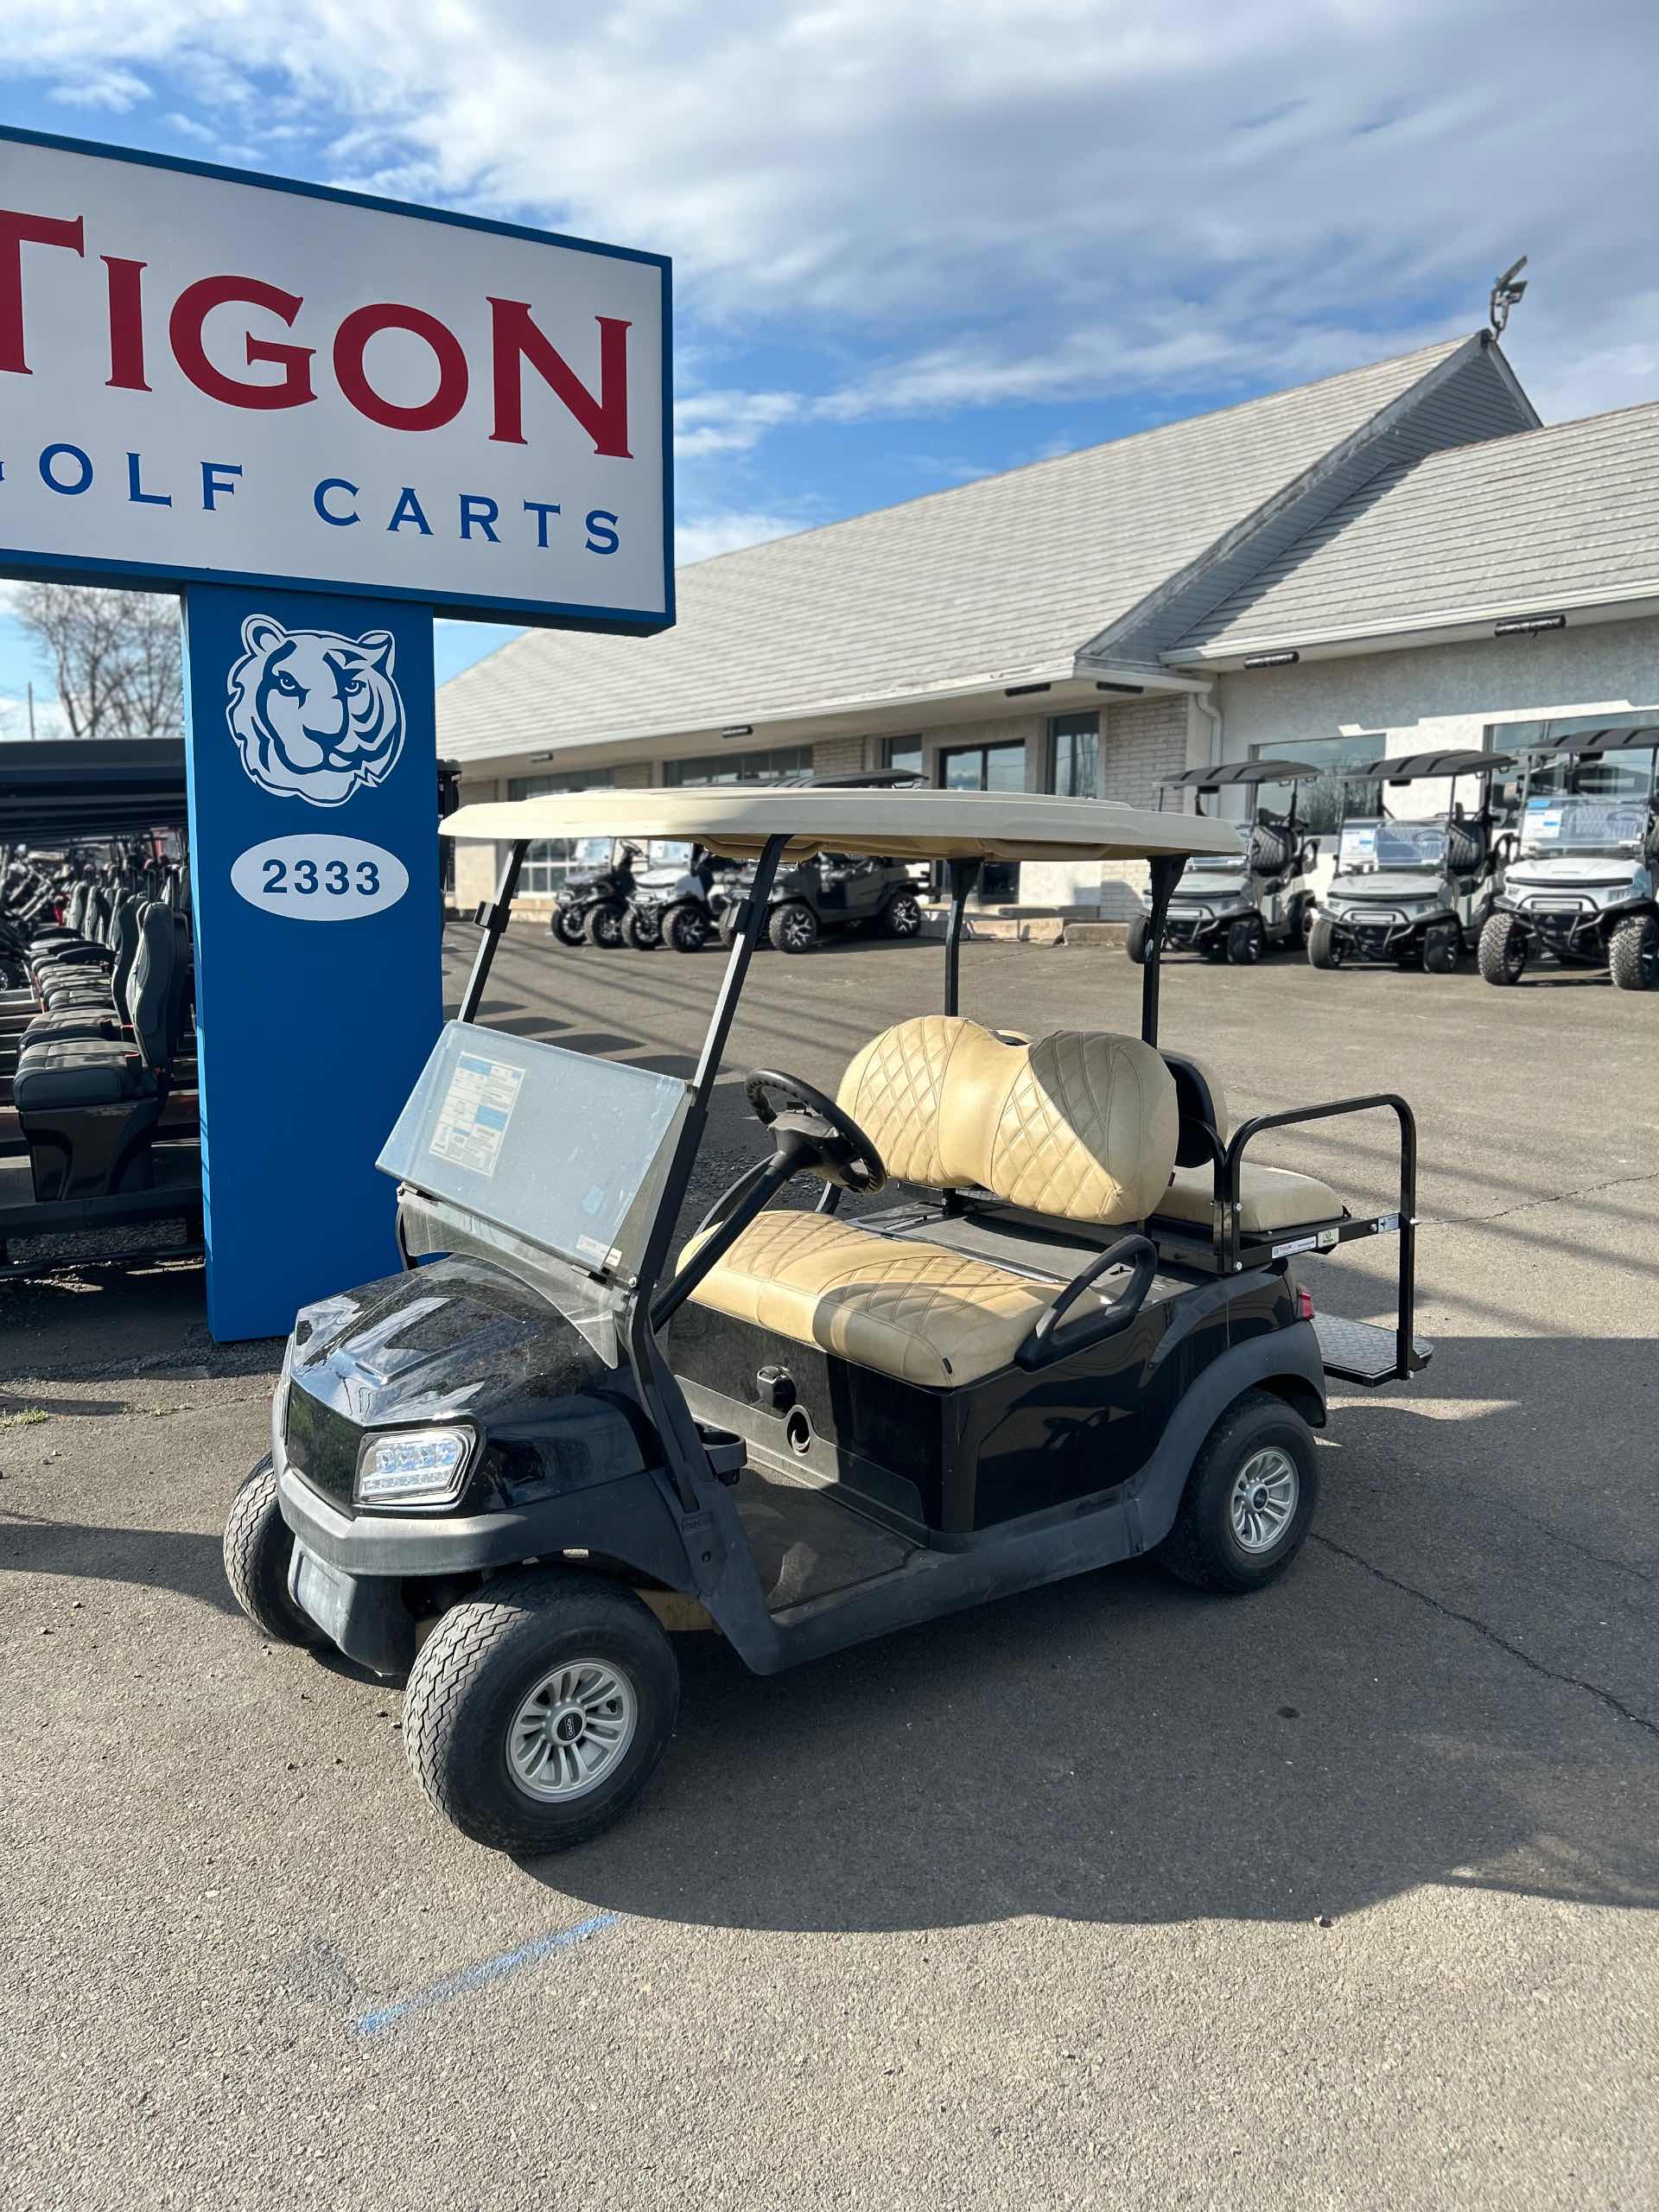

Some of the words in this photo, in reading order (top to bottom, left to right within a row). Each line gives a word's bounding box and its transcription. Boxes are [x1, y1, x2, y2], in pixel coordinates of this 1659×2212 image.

[0, 443, 242, 511] OLF
[314, 478, 620, 554] CARTS
[263, 859, 380, 896] 2333
